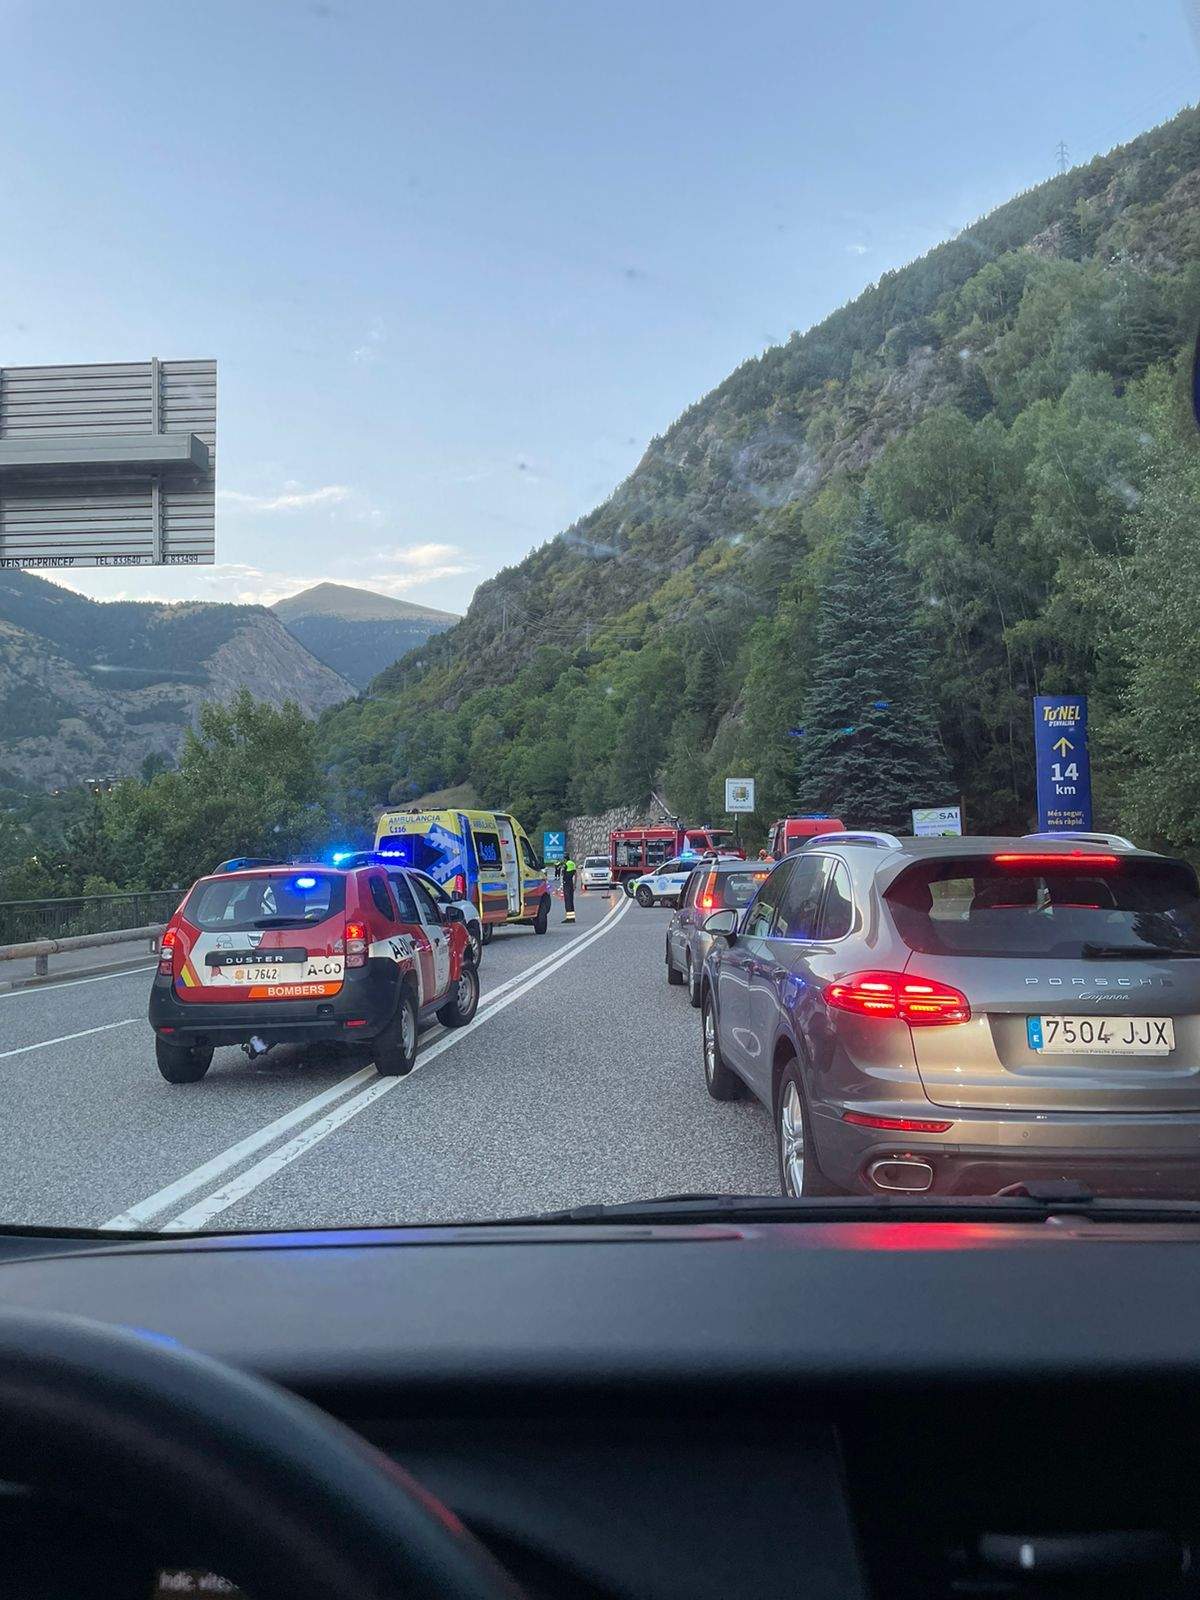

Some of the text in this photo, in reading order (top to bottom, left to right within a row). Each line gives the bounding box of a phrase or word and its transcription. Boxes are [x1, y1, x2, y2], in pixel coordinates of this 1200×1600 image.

[1051, 763, 1079, 782] 14
[1055, 784, 1076, 795] km
[939, 812, 958, 820] SAI
[225, 955, 284, 964] DUSTER
[267, 984, 326, 996] BOMBERS
[1078, 992, 1130, 1004] Cayenne
[1046, 1020, 1168, 1045] 7504 JJX
